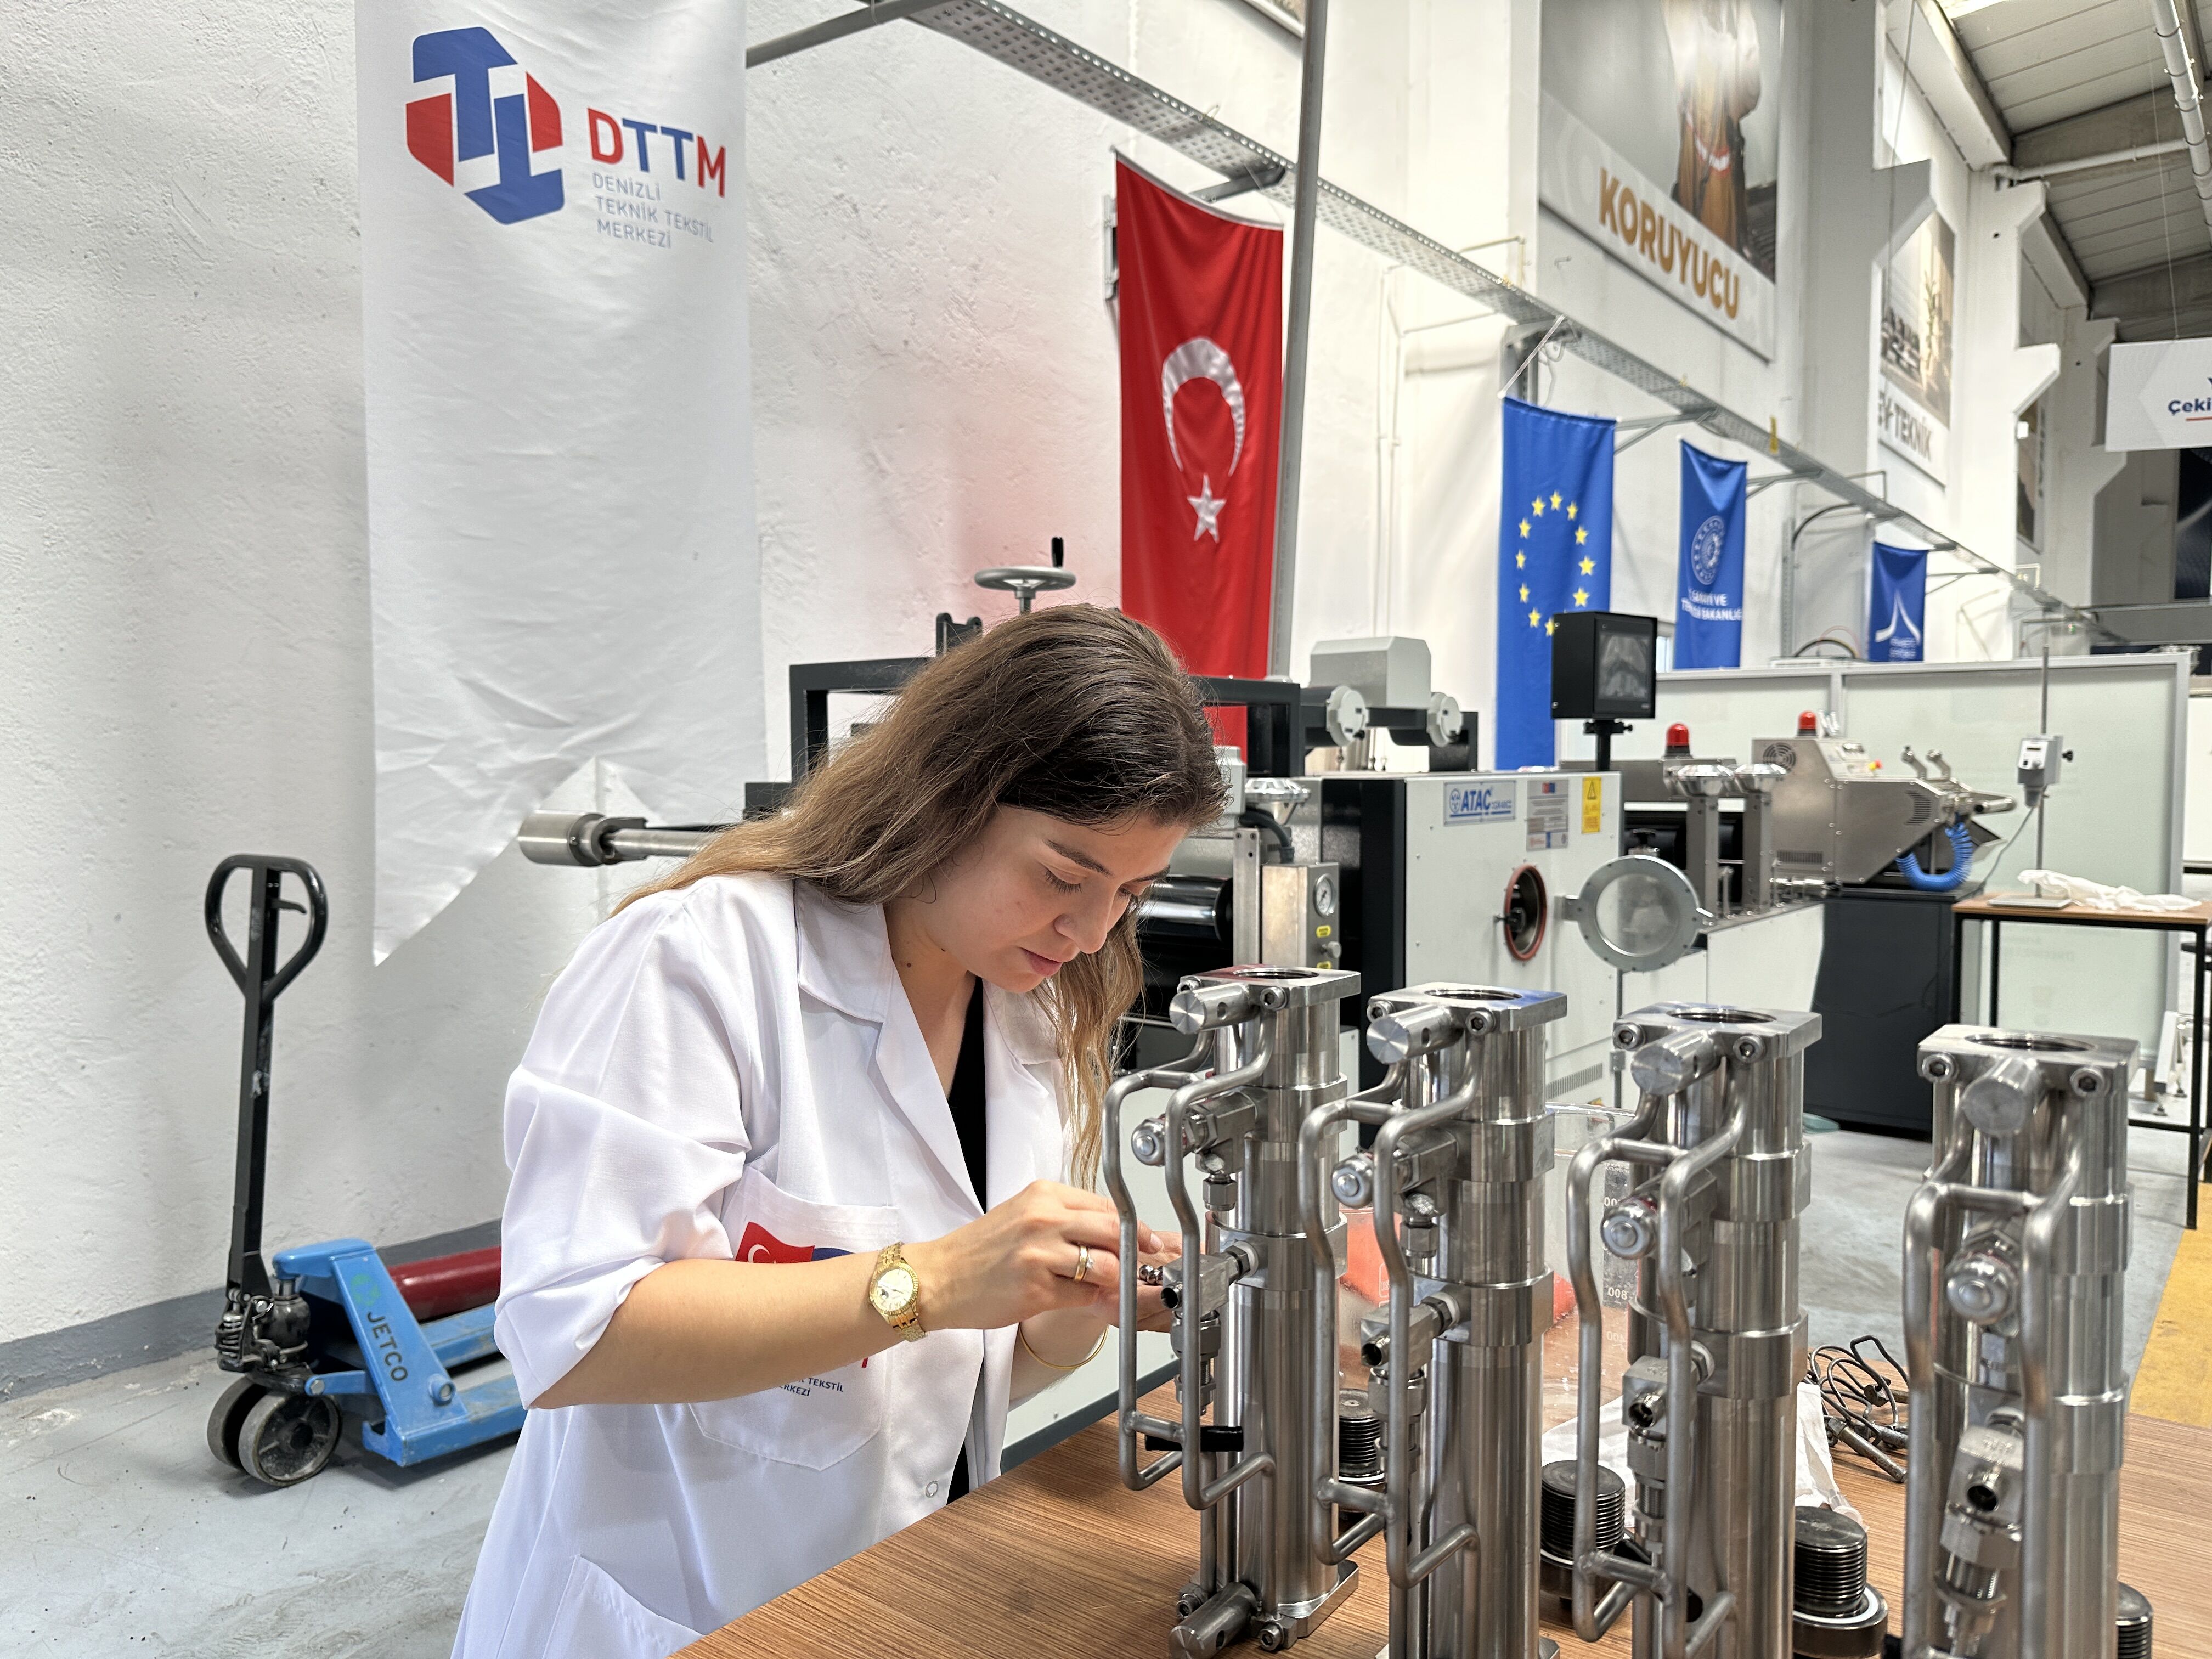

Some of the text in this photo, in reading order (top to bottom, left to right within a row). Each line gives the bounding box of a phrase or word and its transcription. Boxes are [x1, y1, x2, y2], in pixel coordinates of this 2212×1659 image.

[588, 107, 726, 198] DTTM
[592, 171, 661, 201] DENİZLİ
[595, 194, 659, 224] TEKNİK
[597, 218, 672, 249] MERKEZİ
[1599, 167, 1740, 320] KORUYUCU
[366, 1311, 408, 1381] JETCO
[779, 1383, 811, 1397] RKEZİ
[808, 1377, 844, 1392] TEKSTİL
